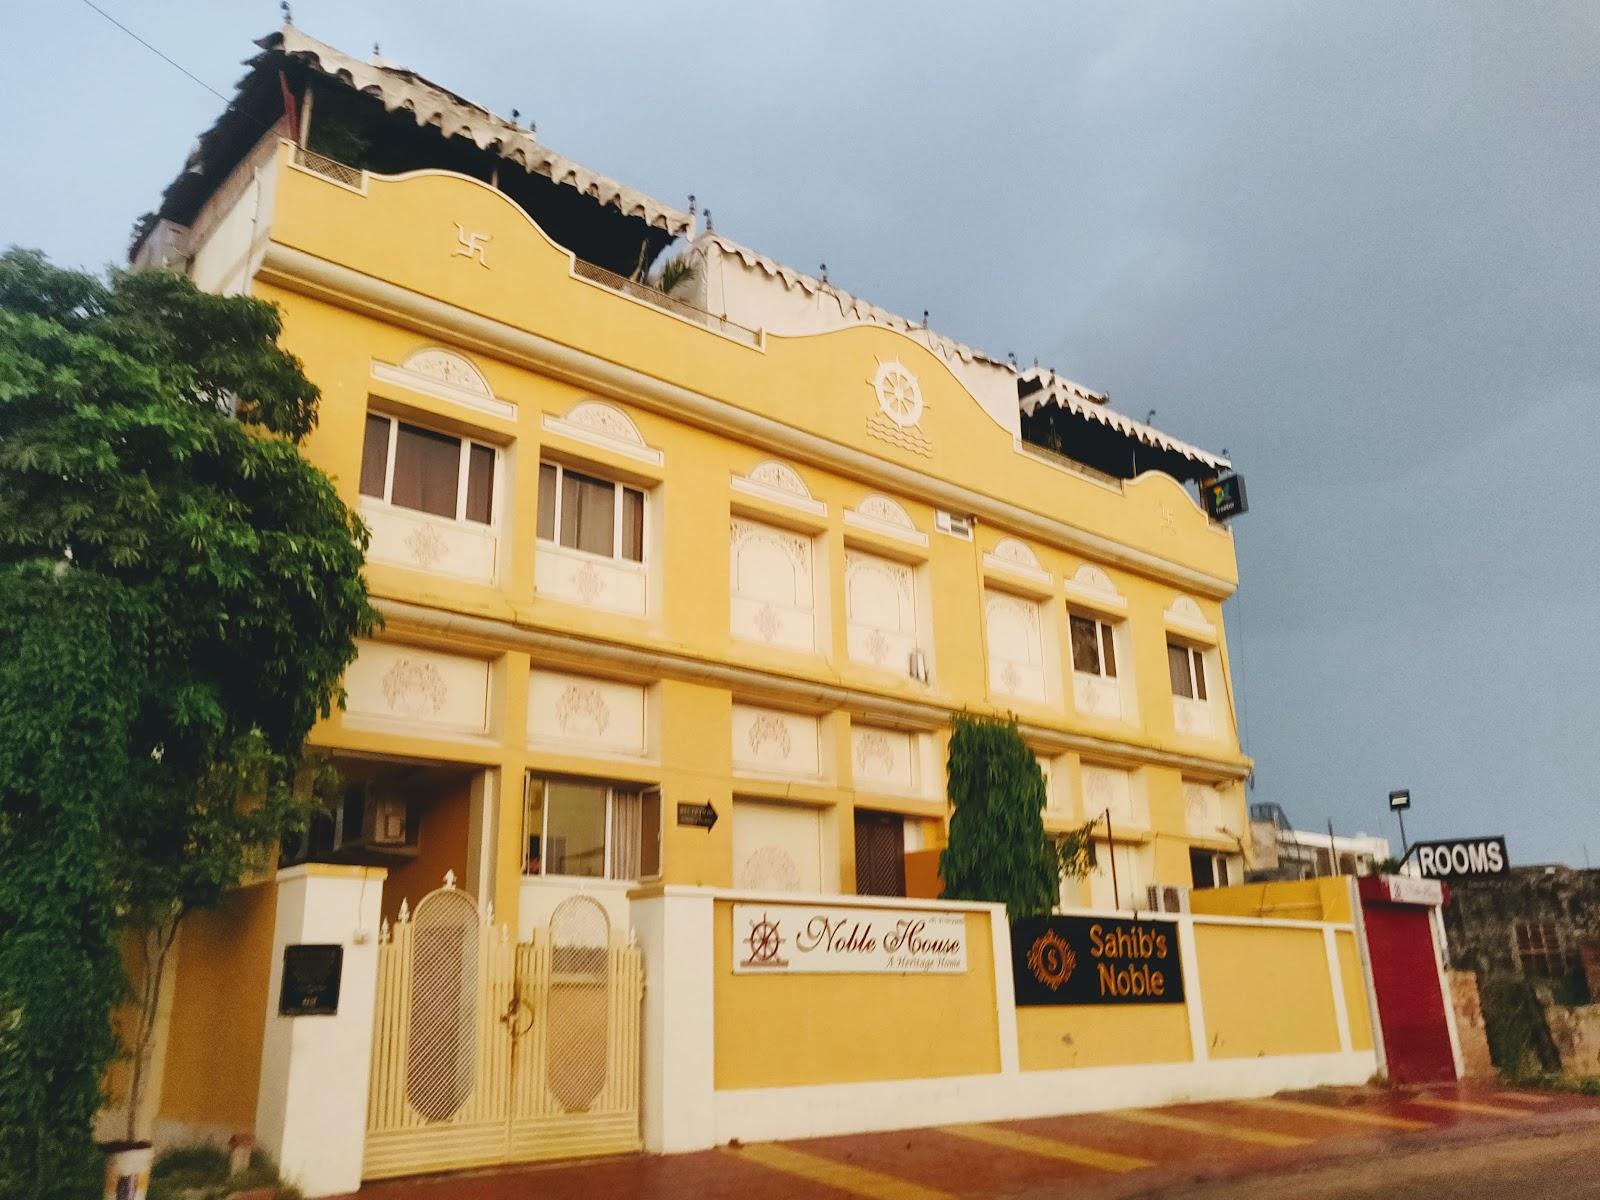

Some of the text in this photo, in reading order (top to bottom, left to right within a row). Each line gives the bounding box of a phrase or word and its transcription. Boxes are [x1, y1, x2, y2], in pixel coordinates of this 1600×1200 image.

[1419, 841, 1503, 876] ROOMS
[796, 915, 960, 955] Noble House
[1089, 923, 1168, 959] Sahib's
[886, 956, 895, 968] A
[898, 956, 935, 971] Heritage
[1097, 962, 1165, 997] Noble
